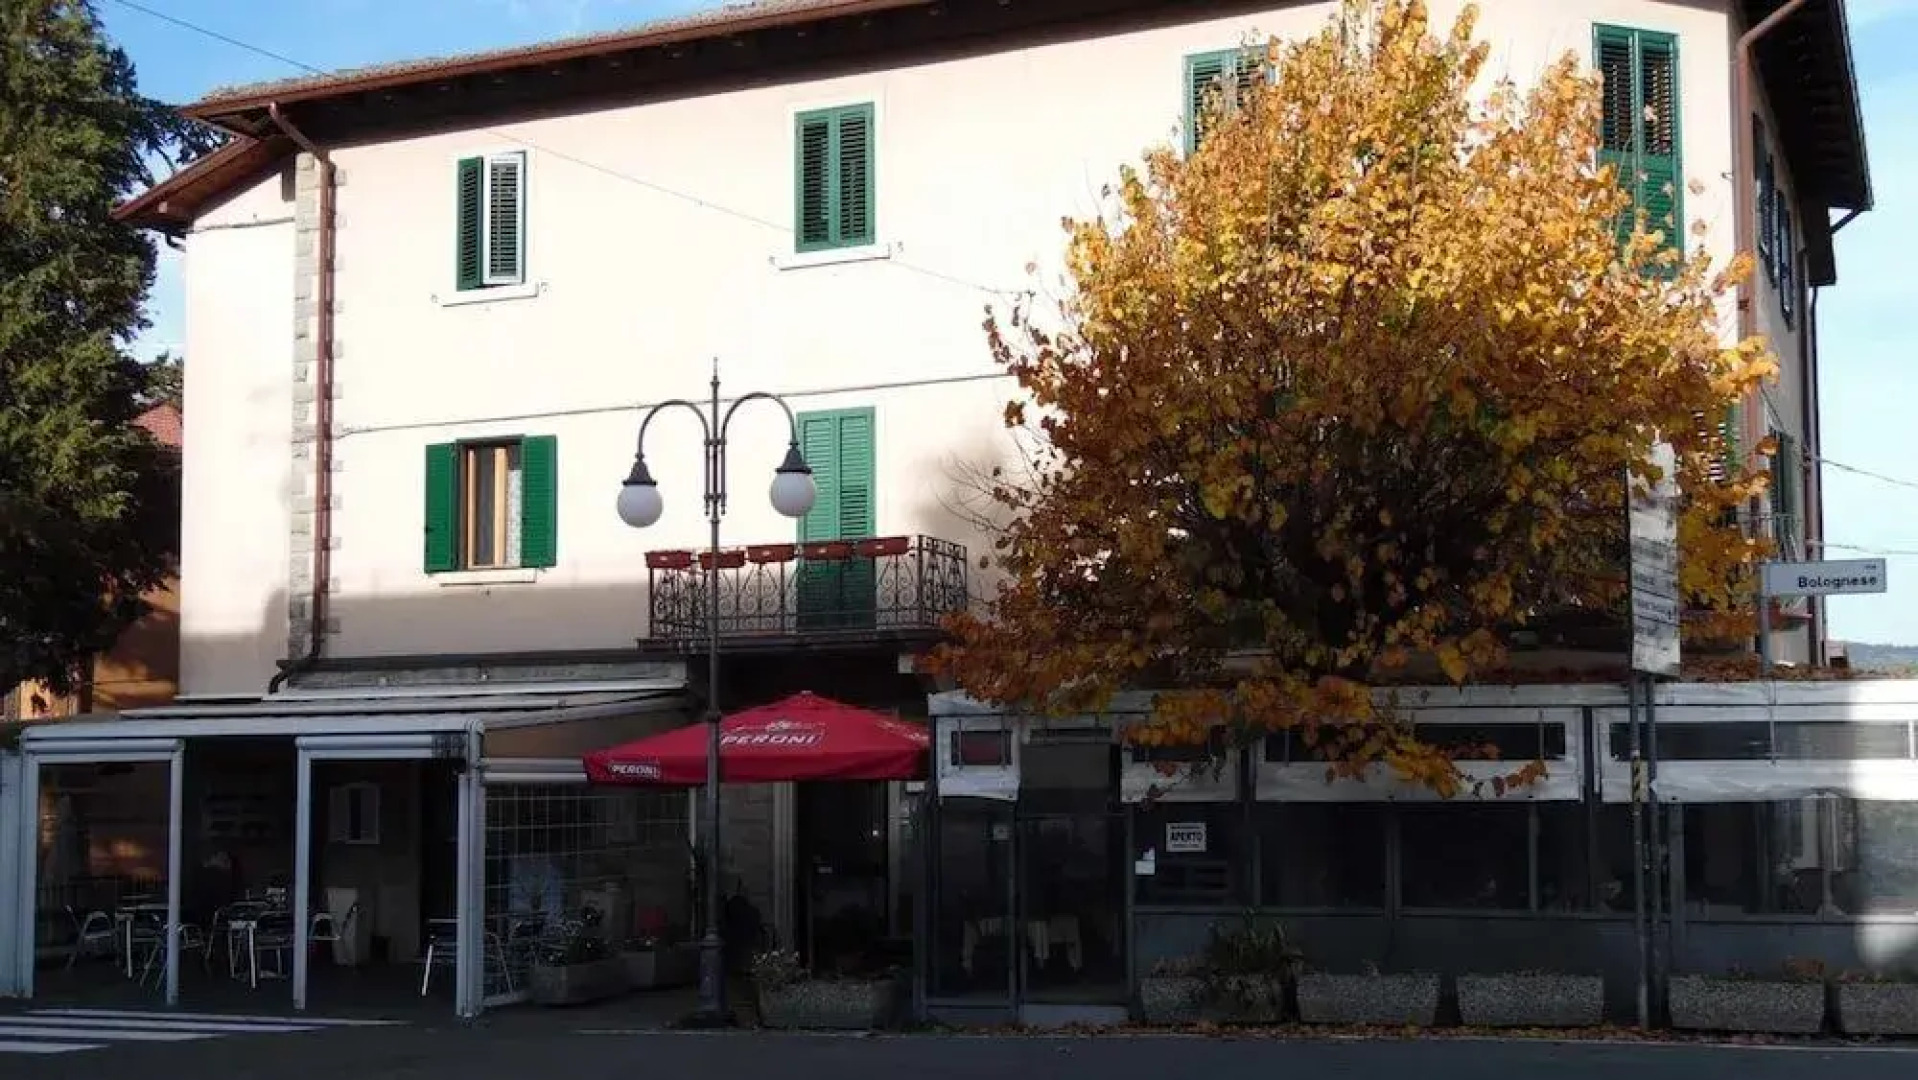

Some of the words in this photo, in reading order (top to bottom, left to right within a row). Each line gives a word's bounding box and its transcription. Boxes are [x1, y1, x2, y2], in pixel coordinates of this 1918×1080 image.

[1798, 576, 1877, 589] Bolognese
[720, 733, 818, 746] PERONI
[611, 764, 657, 776] PERONI
